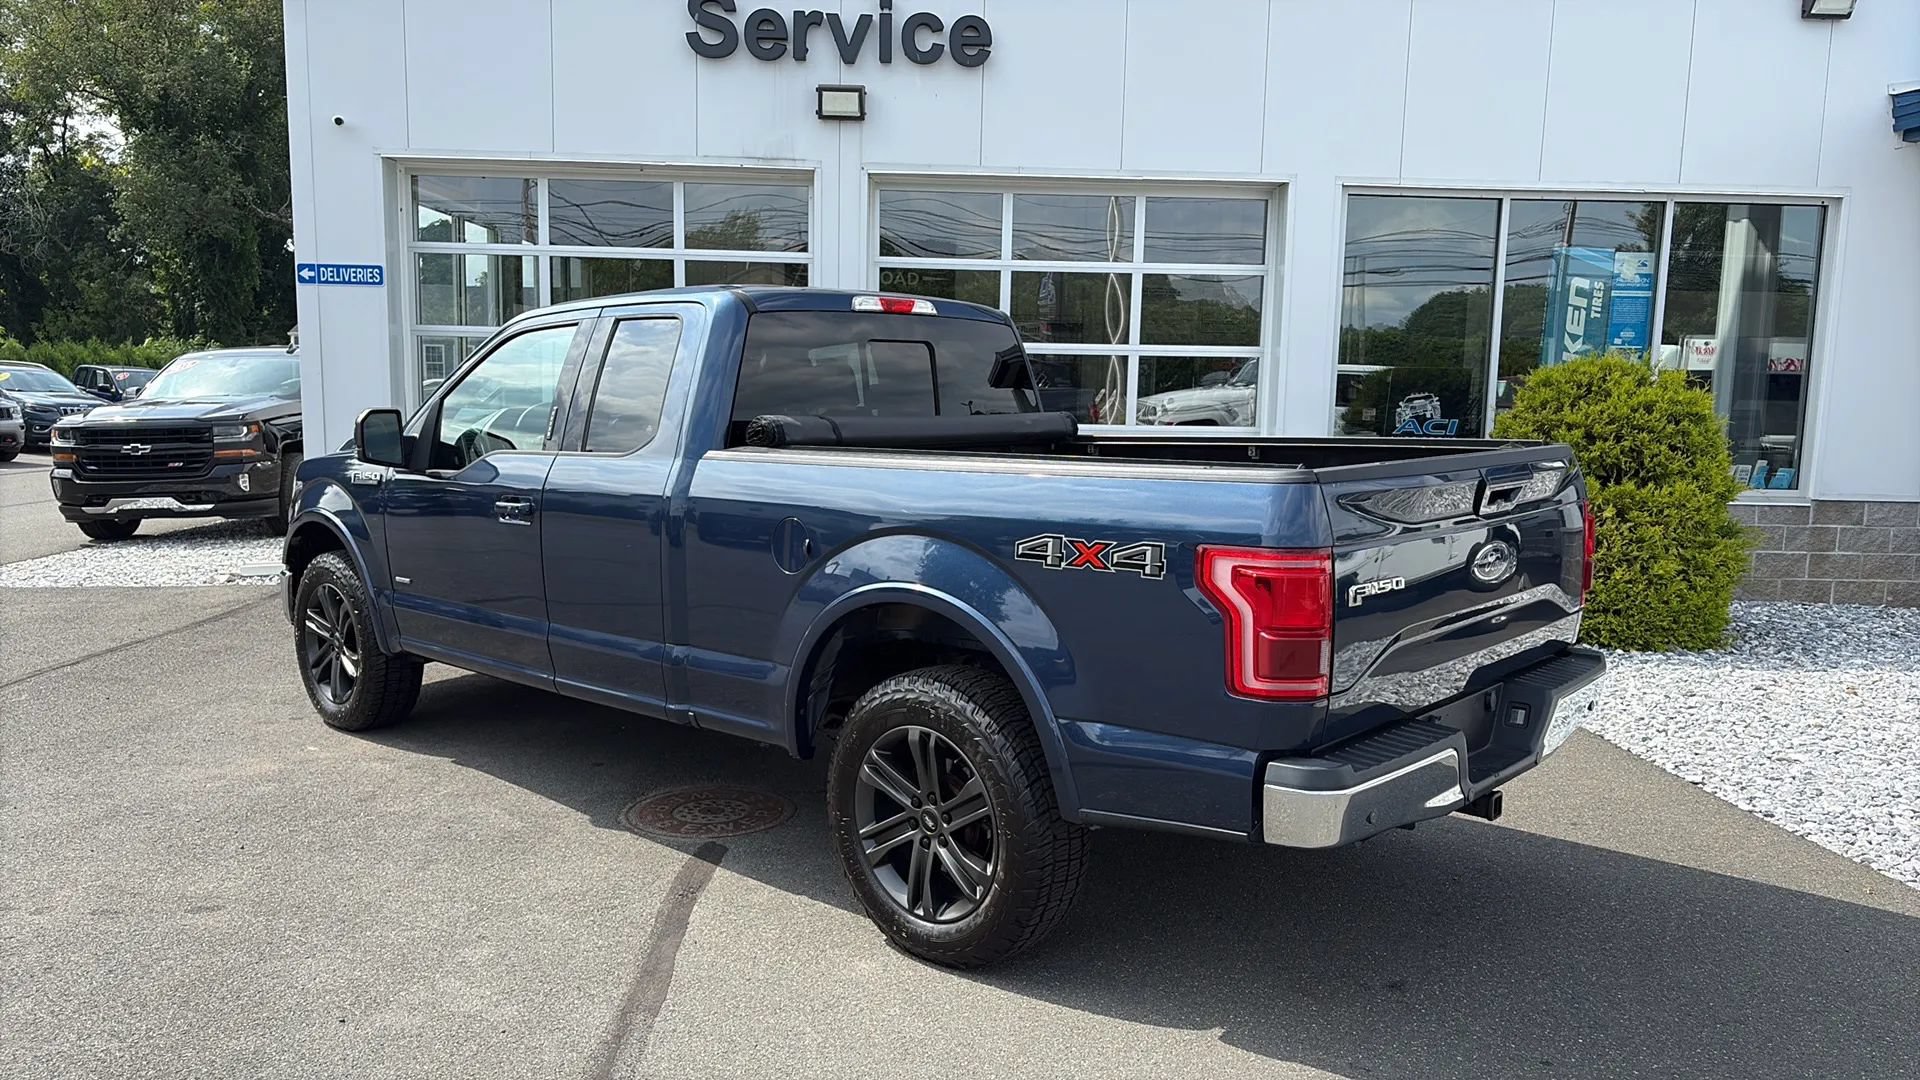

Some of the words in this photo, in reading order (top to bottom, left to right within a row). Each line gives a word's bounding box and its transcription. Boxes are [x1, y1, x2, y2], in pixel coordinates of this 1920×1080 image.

[685, 0, 993, 67] Service
[319, 267, 381, 283] DELIVERIES
[1590, 281, 1605, 319] TIRES
[1392, 418, 1459, 436] ACI
